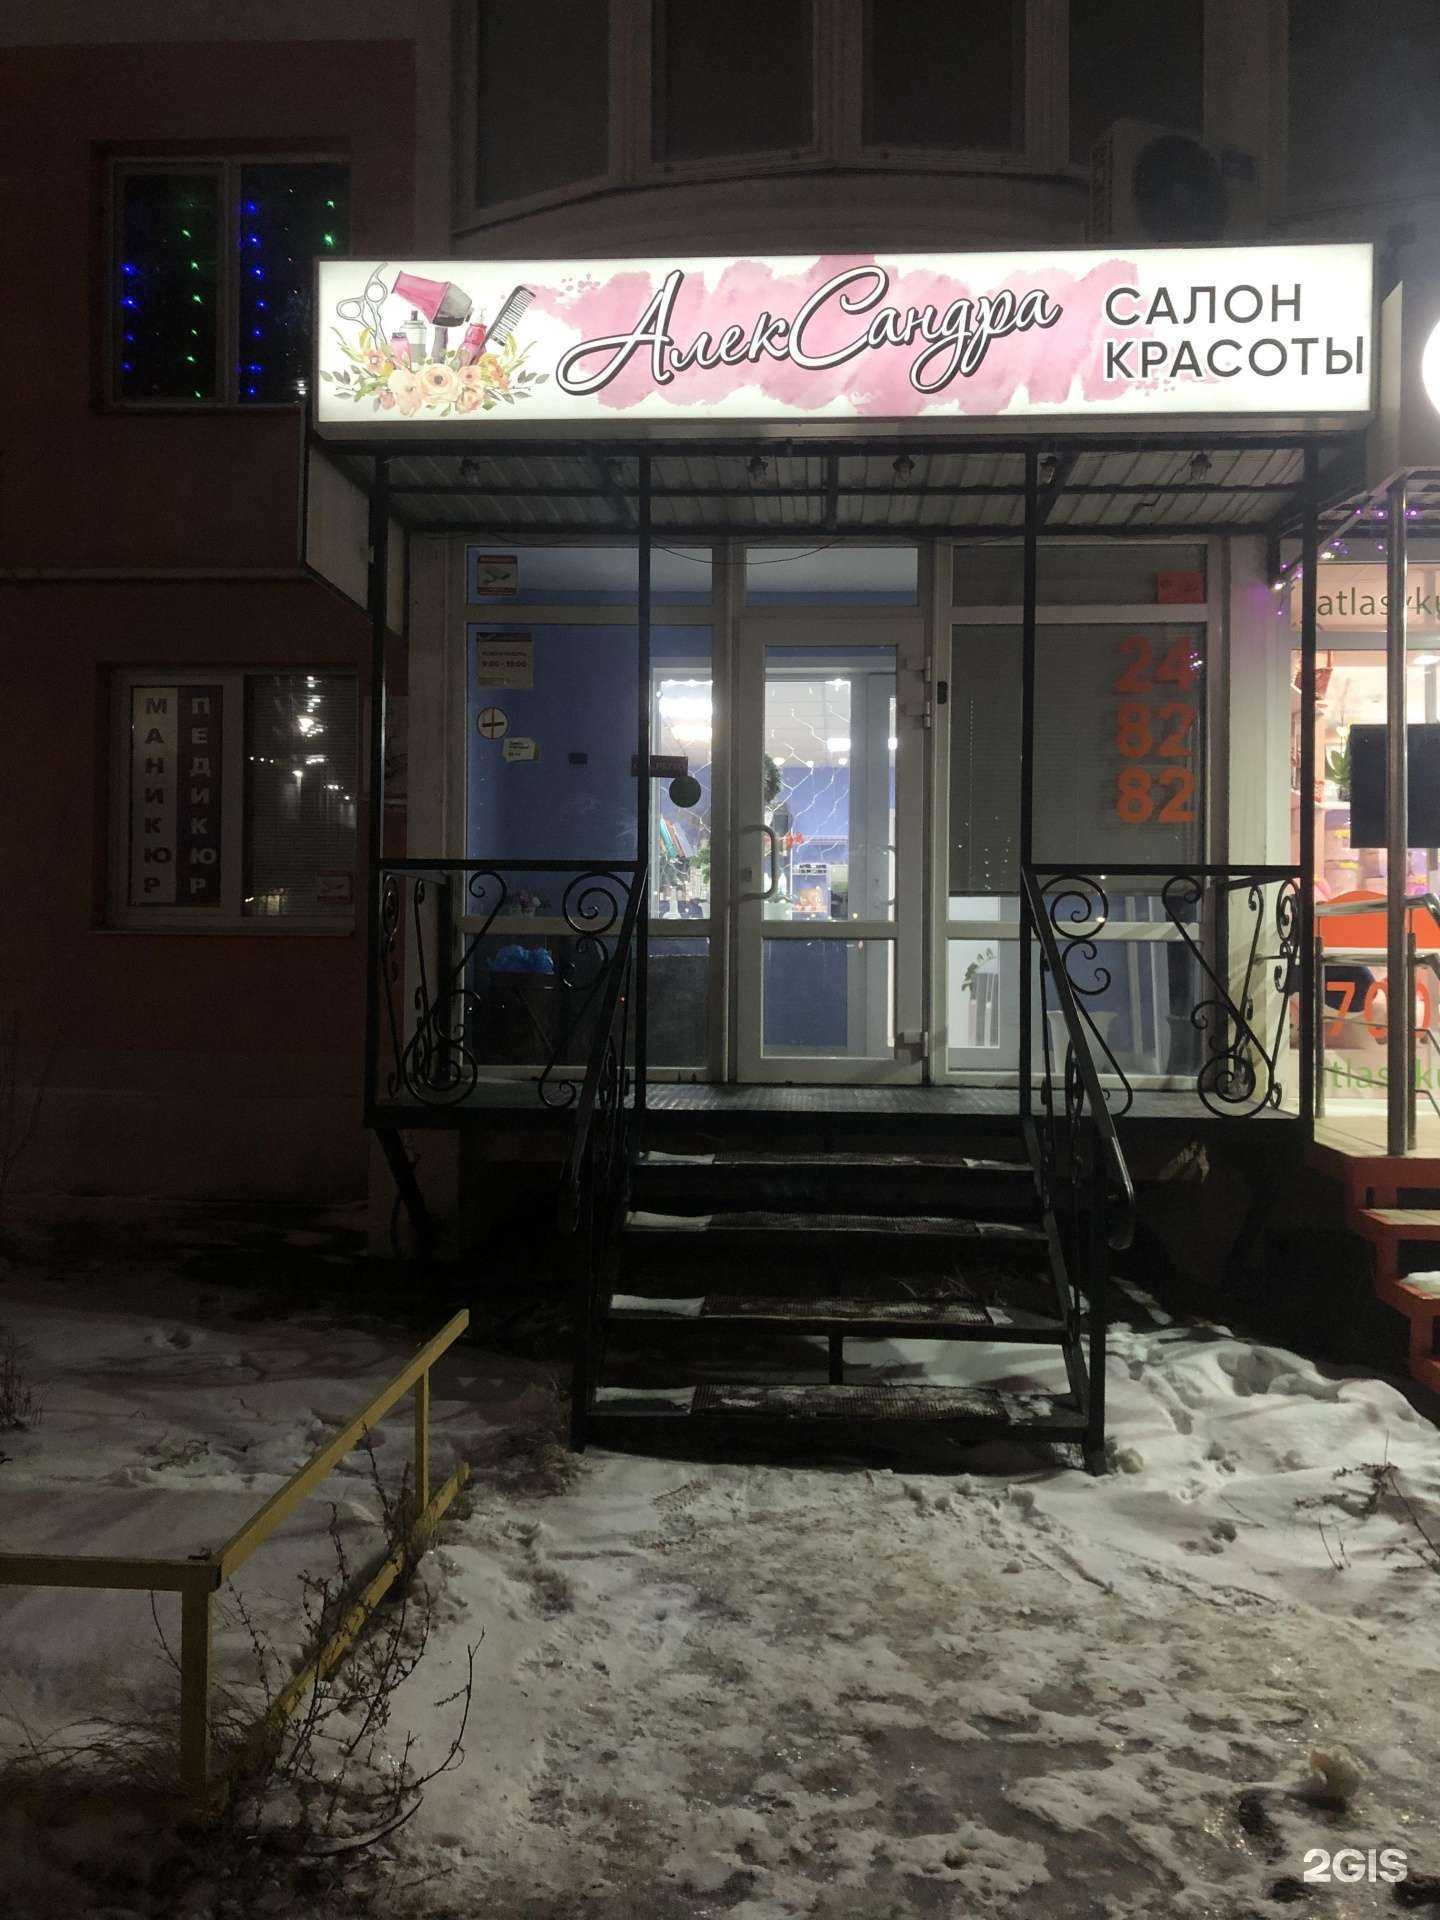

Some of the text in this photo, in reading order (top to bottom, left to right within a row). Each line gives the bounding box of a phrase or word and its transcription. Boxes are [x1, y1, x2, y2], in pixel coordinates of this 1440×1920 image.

[556, 266, 1064, 396] АлекСандра
[1105, 283, 1302, 326] САЛОН
[1106, 336, 1364, 379] КРАСОТЫ
[1112, 634, 1197, 693] 24
[1115, 701, 1197, 759] 82
[143, 697, 173, 894] МАНИКЮР
[189, 696, 218, 895] ПЕДИКЮР
[1115, 765, 1197, 825] 82
